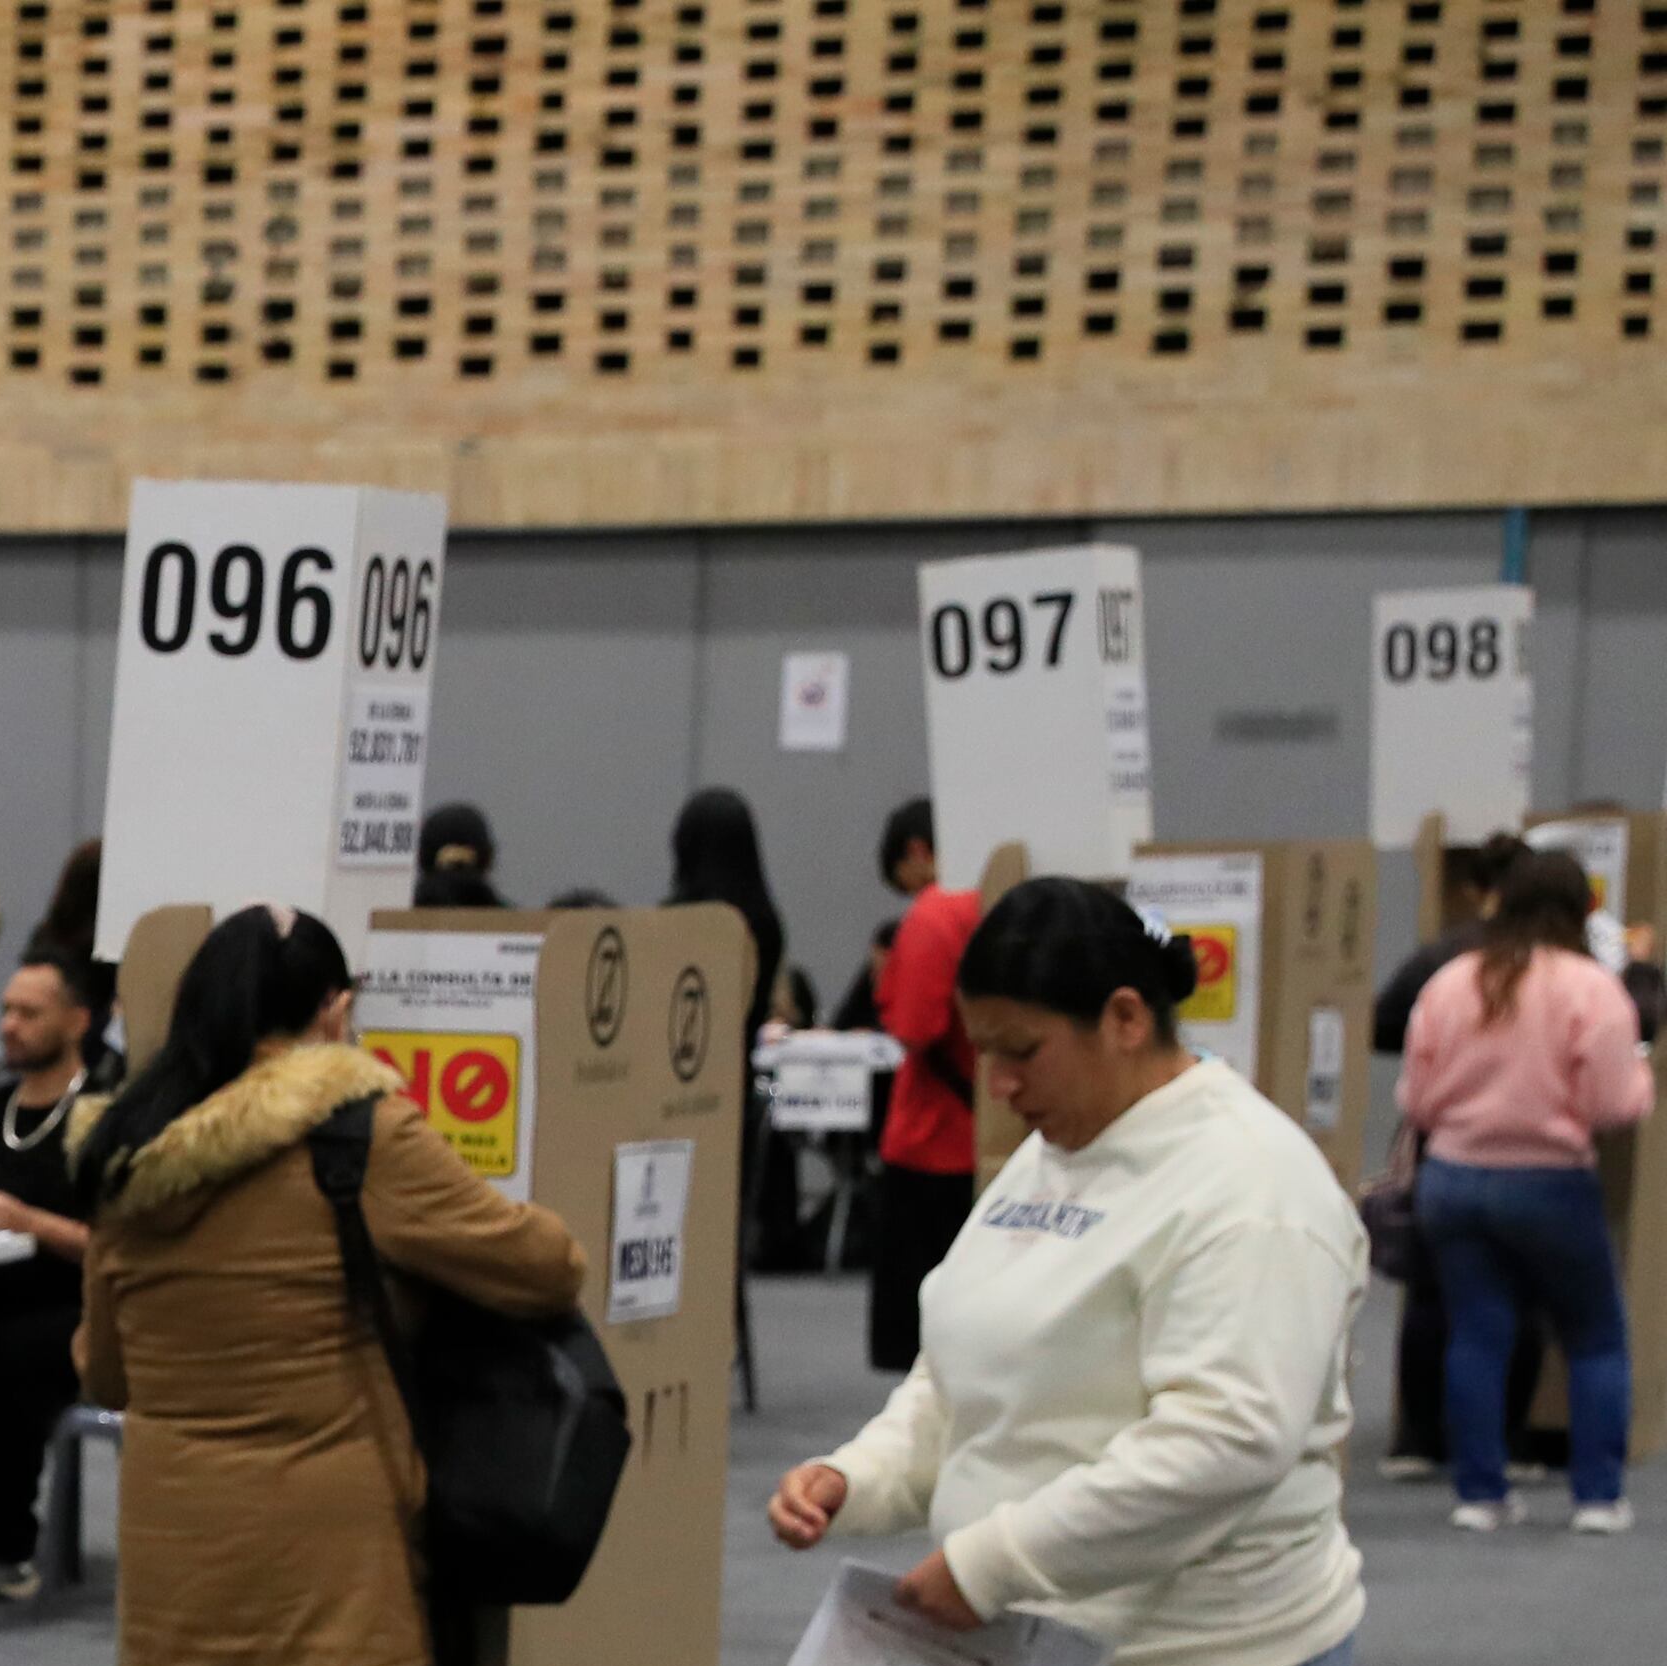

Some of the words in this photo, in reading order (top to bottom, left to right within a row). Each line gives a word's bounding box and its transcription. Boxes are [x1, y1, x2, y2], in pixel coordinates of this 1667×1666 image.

[140, 541, 334, 661] 096
[360, 555, 434, 669] 096
[932, 591, 1075, 680] 097
[1386, 617, 1499, 684] 098
